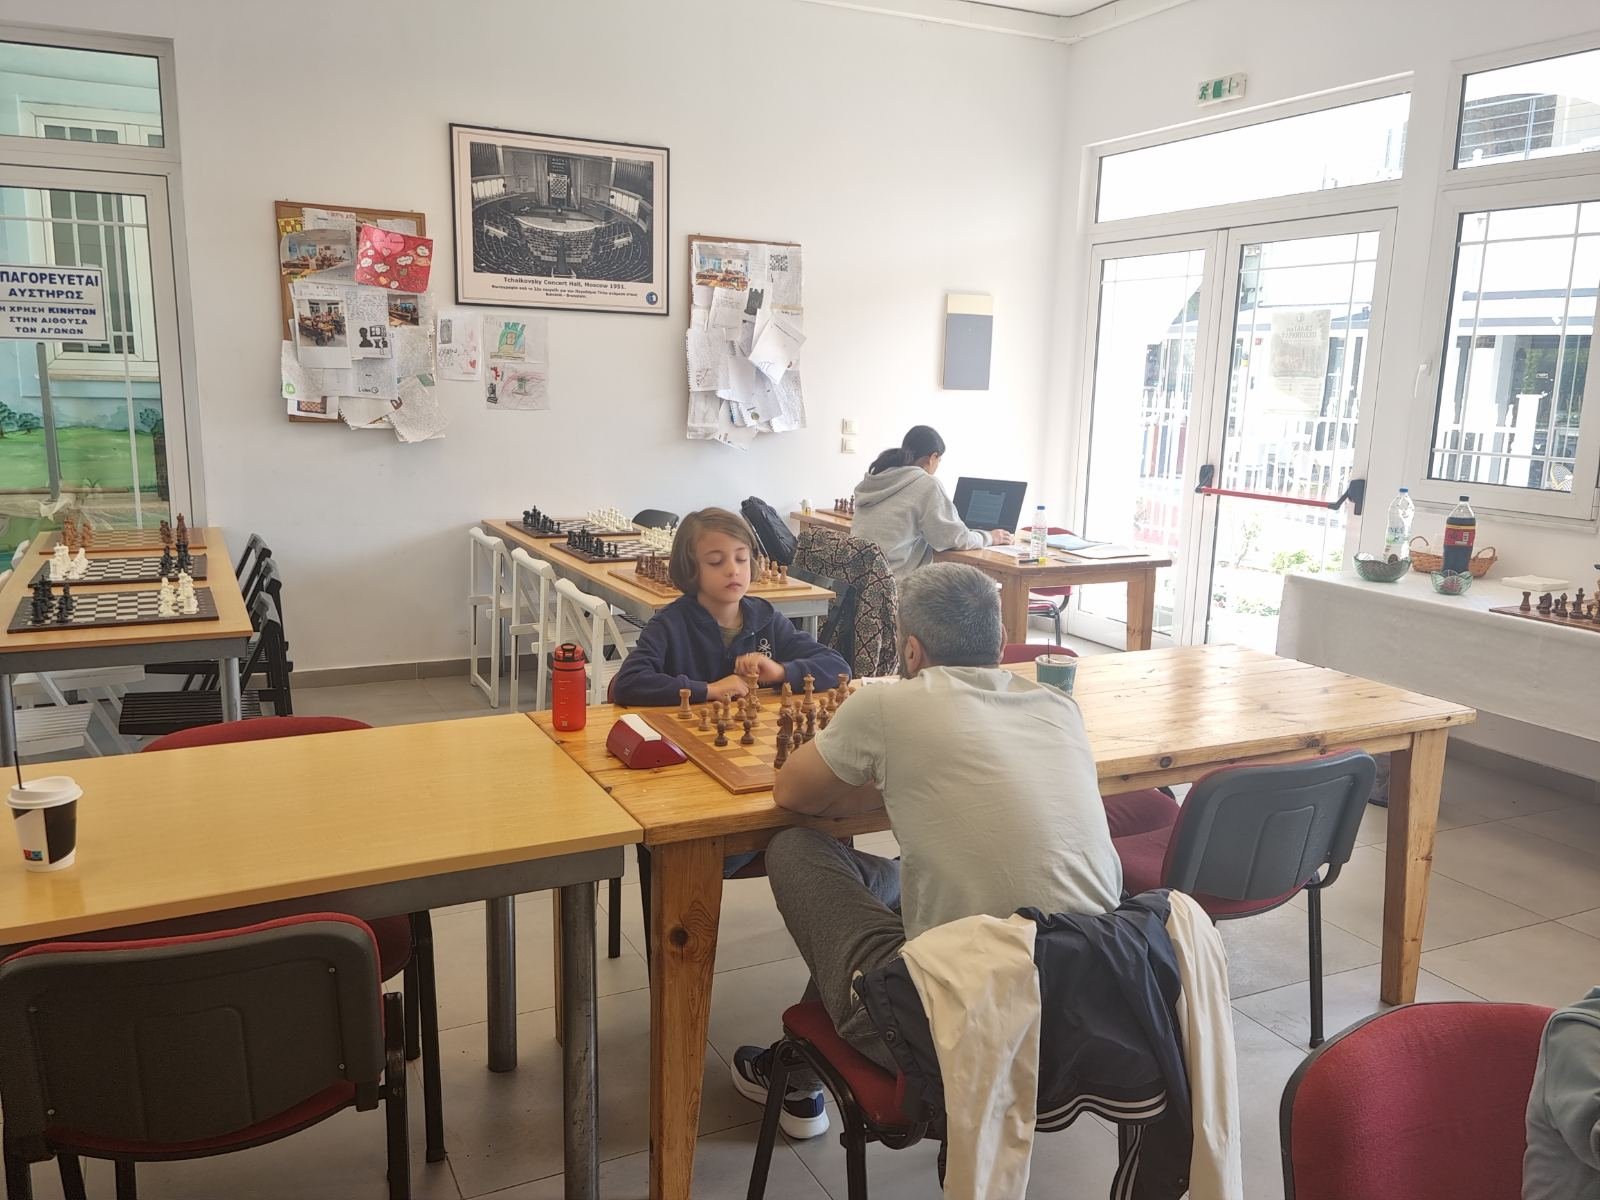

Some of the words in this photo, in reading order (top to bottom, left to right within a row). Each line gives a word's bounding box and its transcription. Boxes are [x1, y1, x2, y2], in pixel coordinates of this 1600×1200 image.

[503, 277, 542, 285] Tchaikovsky
[8, 288, 84, 300] ΑΥΣΤΗΡΩΣ
[41, 317, 88, 325] ΑΙΘΟΥΣΑ
[40, 327, 84, 335] ΑΓΩΝΩΝ
